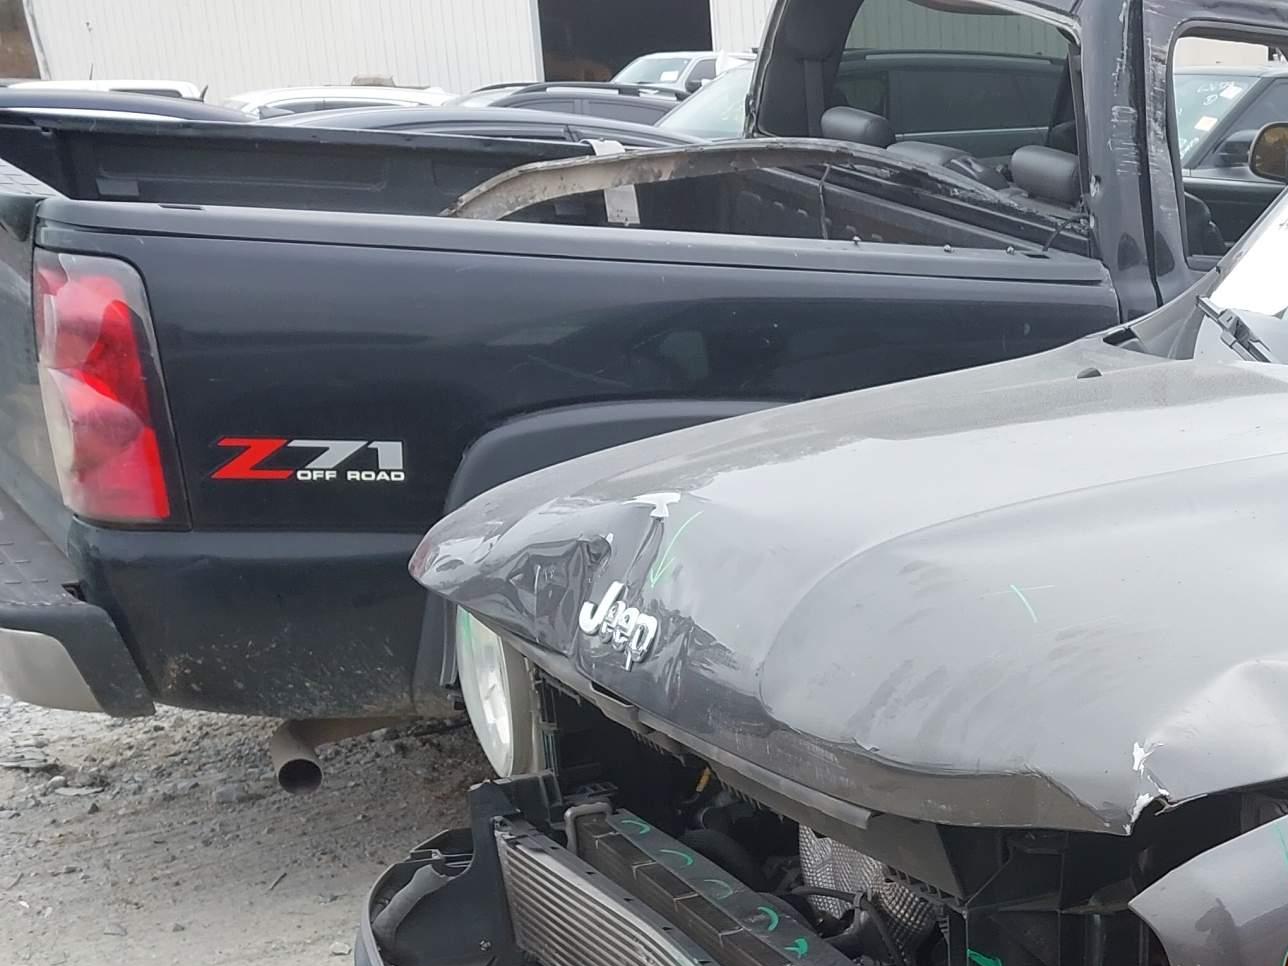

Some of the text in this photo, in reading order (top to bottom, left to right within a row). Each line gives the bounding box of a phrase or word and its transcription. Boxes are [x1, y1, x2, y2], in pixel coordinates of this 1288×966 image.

[210, 437, 404, 479] Z71
[296, 469, 405, 481] OFF ROAD
[579, 581, 658, 671] Jeep
